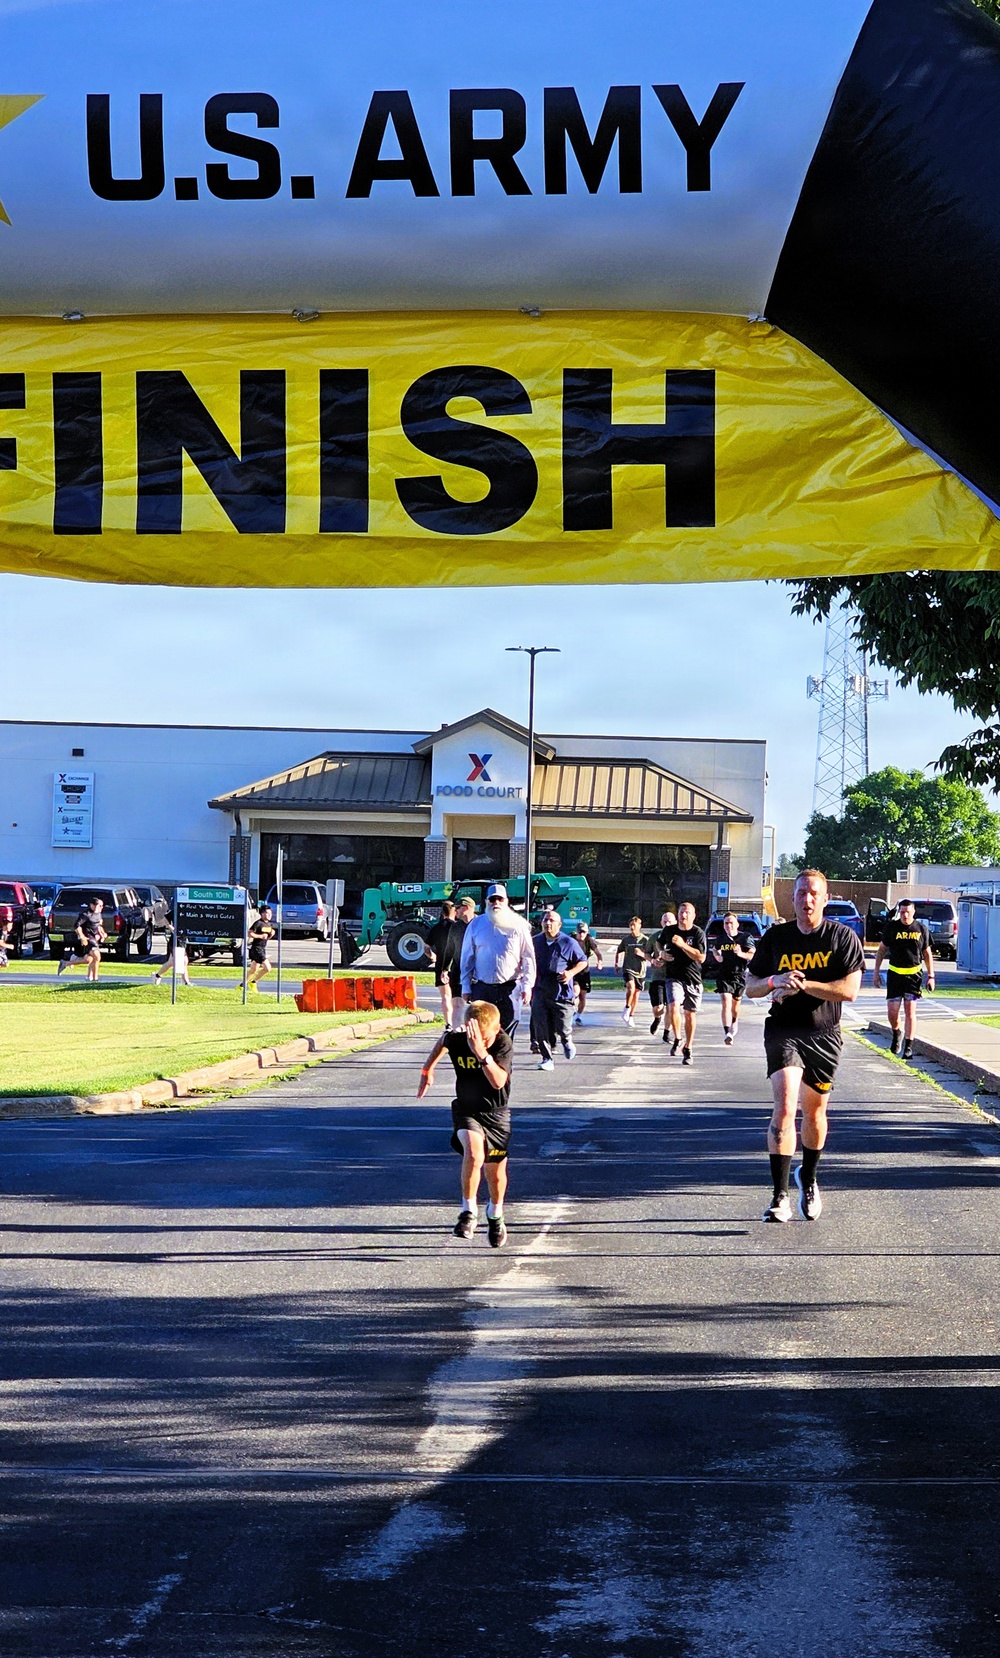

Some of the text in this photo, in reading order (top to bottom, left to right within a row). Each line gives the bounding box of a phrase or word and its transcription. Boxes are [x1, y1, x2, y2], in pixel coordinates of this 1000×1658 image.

[86, 82, 745, 201] U.S. ARMY
[0, 365, 716, 535] INISH
[436, 785, 523, 799] FOOD COURT
[397, 884, 422, 893] JCB
[896, 931, 921, 940] ARMY
[778, 951, 832, 971] ARMY
[457, 1056, 481, 1069] AR
